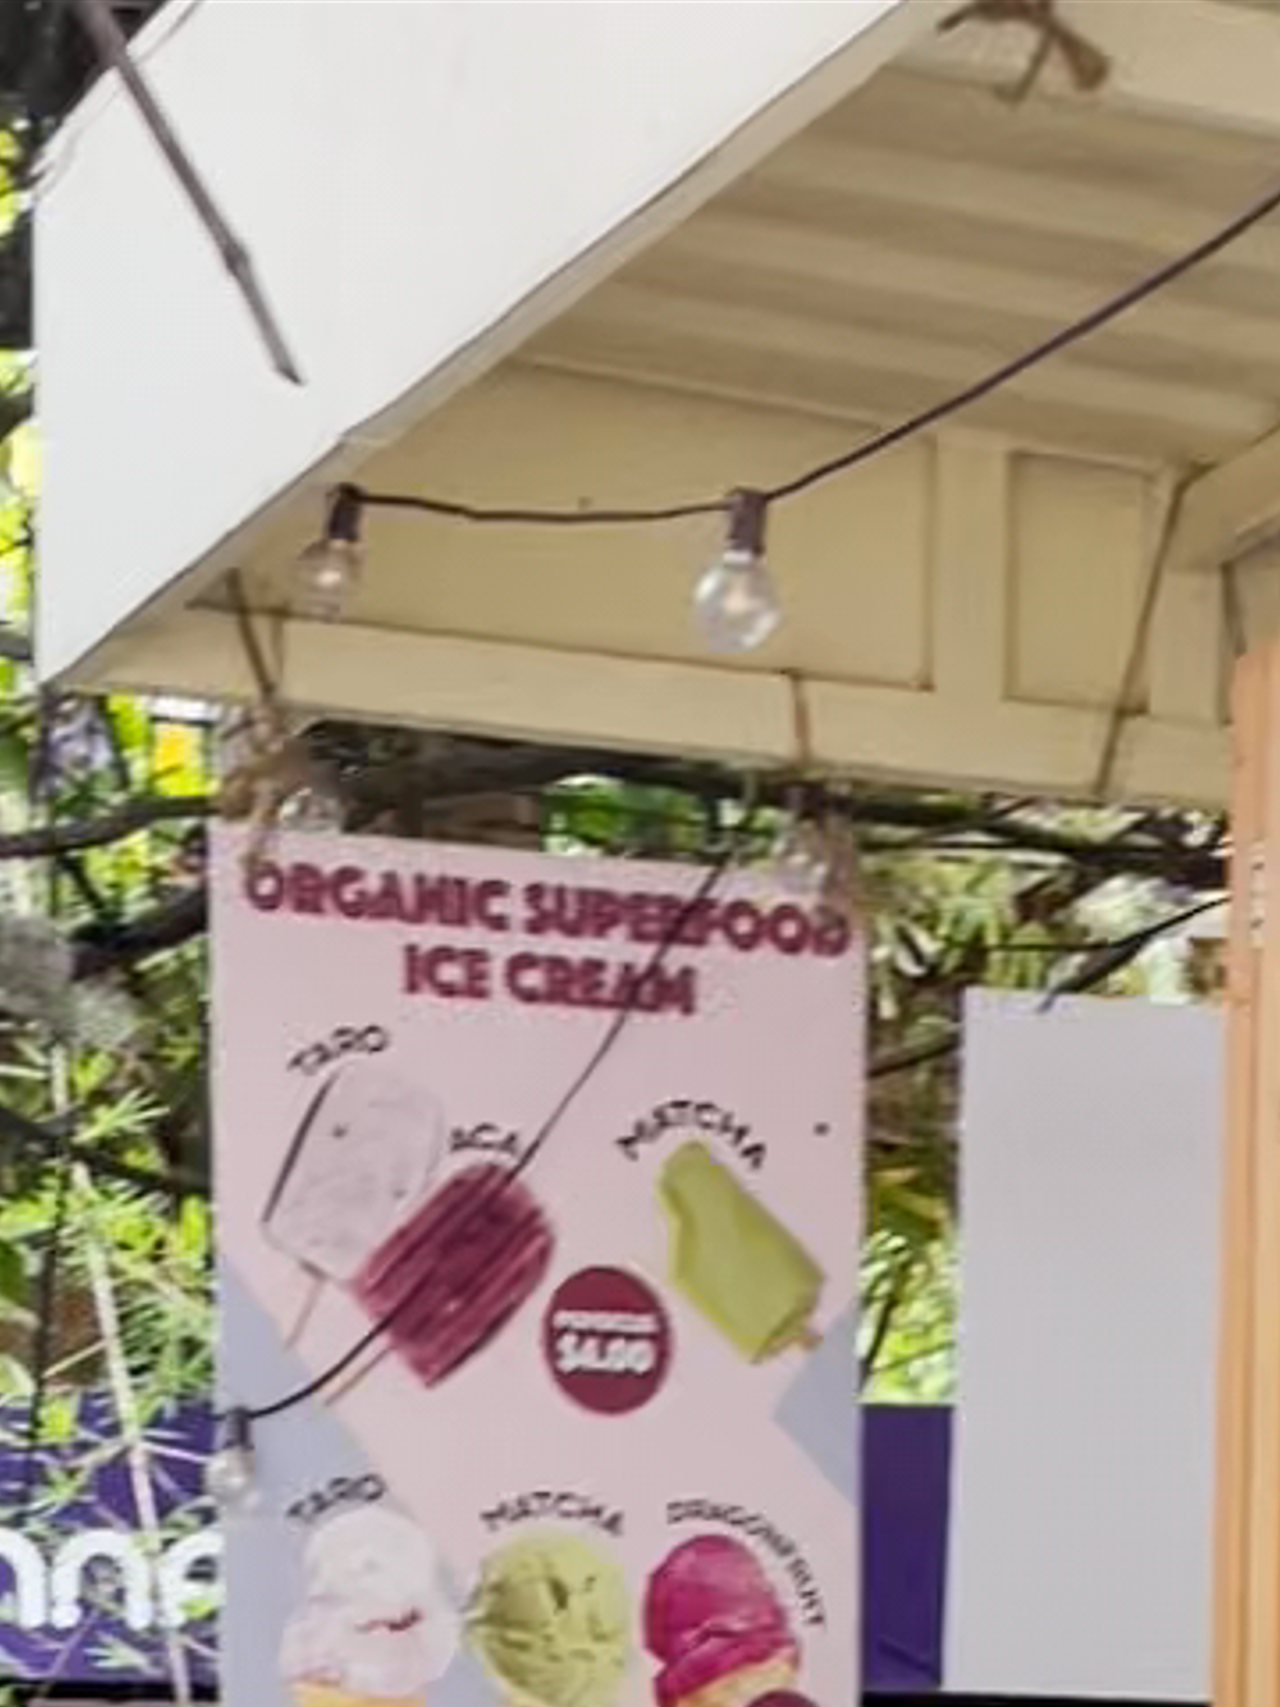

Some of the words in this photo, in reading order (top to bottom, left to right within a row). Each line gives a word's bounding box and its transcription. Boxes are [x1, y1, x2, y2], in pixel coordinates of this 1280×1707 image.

[246, 862, 510, 931] ORGANIC
[525, 883, 852, 956] SUPERFOOD
[404, 944, 490, 997] ICE
[504, 953, 698, 1017] CREAM
[618, 1100, 767, 1169] MATCHA
[480, 1490, 624, 1536] MATCHA
